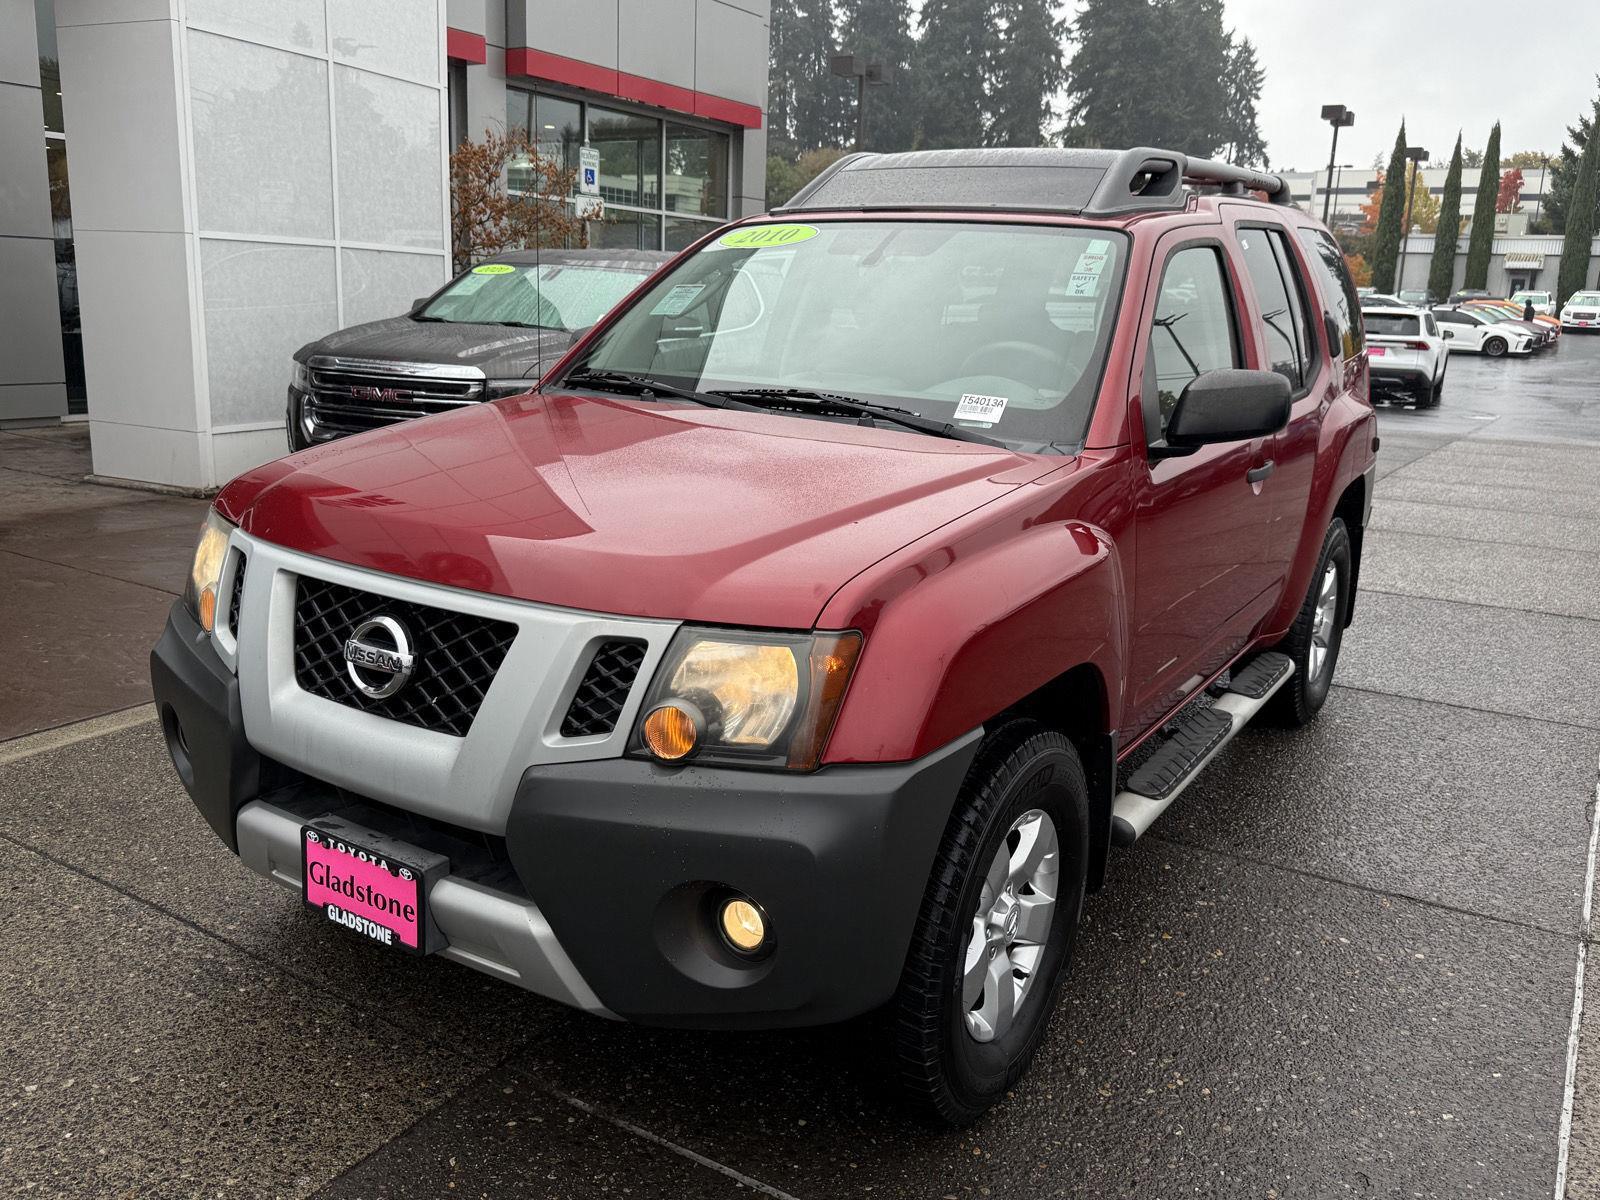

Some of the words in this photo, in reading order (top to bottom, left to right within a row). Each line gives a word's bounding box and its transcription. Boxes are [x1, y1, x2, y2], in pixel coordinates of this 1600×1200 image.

[734, 228, 801, 244] 2010
[351, 385, 412, 403] GMC
[962, 395, 1004, 408] T54013A
[346, 641, 403, 673] NISSAN
[327, 837, 389, 871] TOYOTA
[309, 861, 415, 922] Gladstone
[327, 904, 392, 946] GLADSTONE
